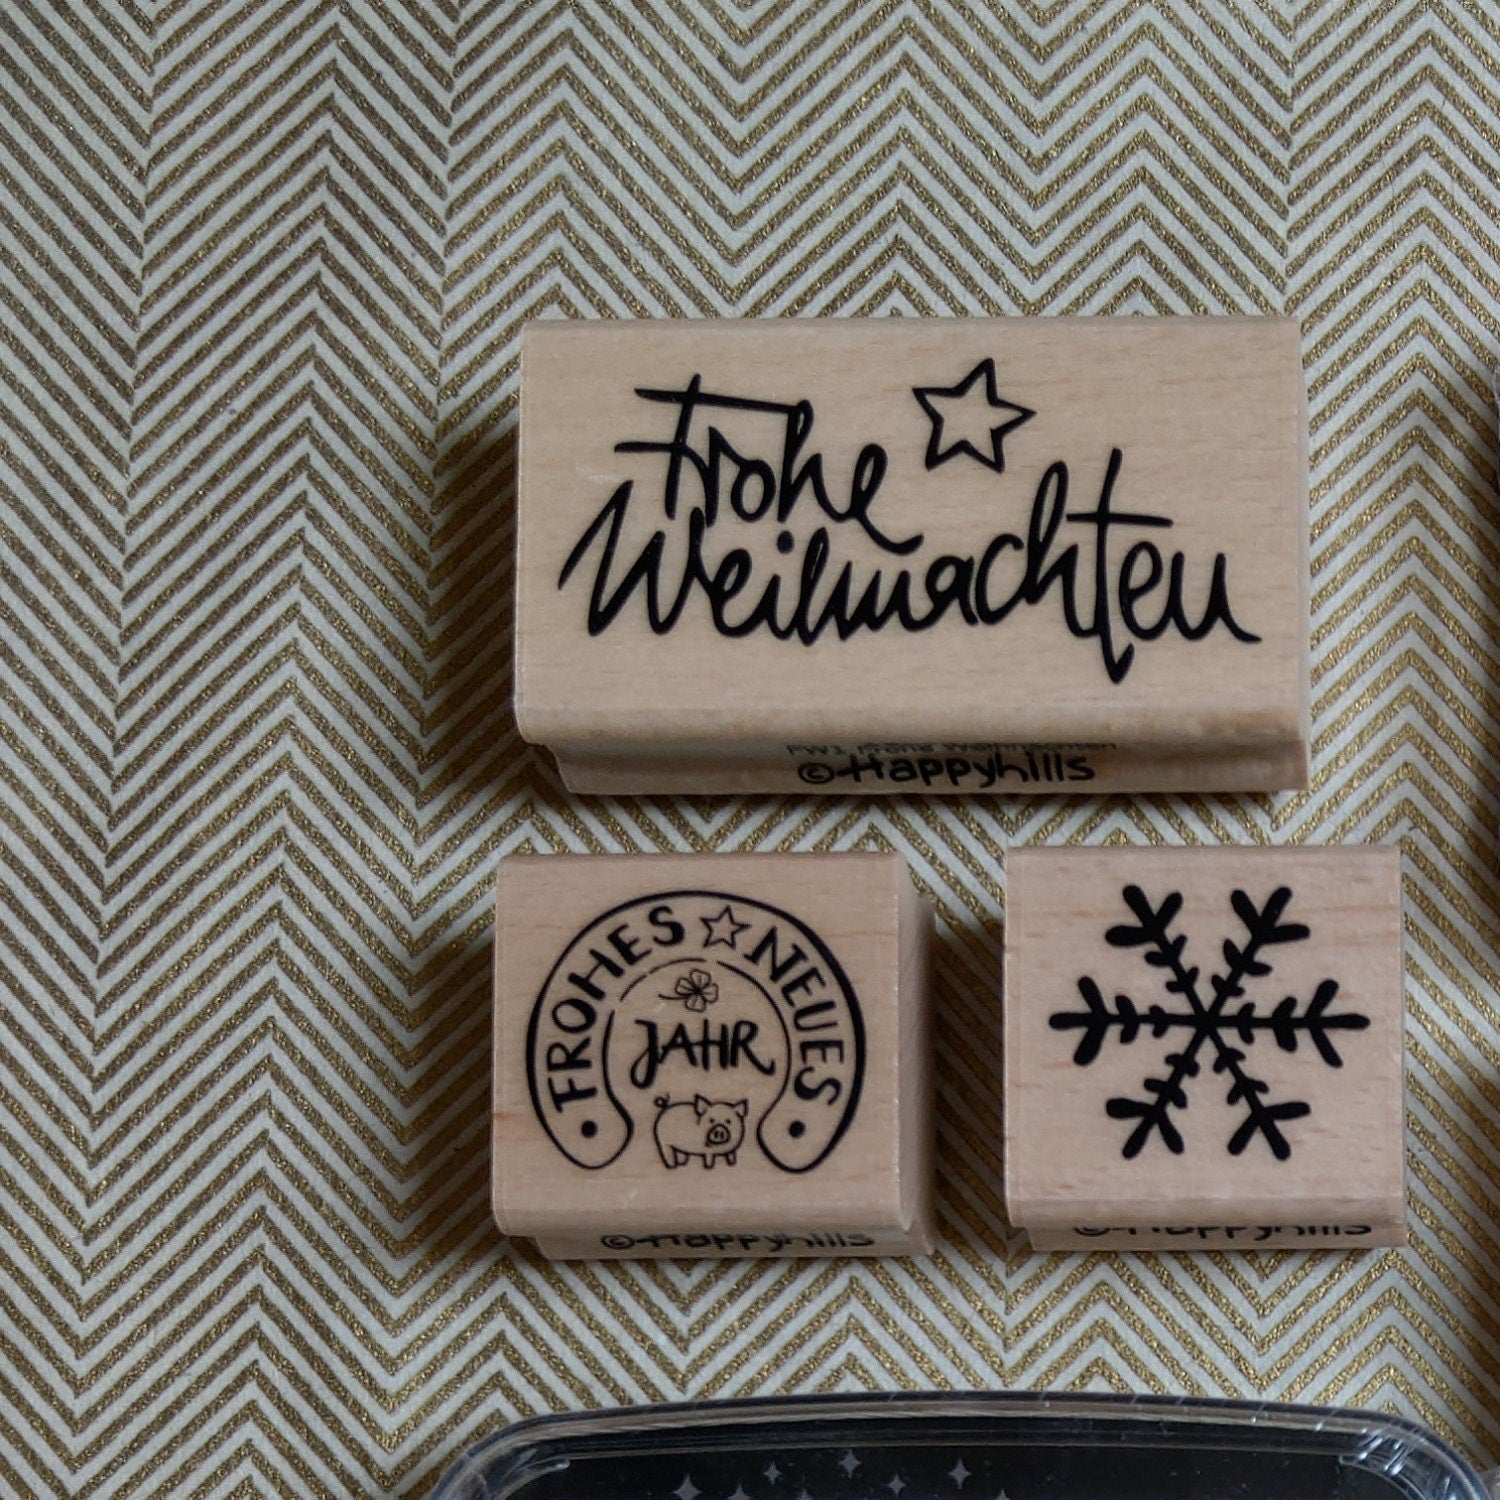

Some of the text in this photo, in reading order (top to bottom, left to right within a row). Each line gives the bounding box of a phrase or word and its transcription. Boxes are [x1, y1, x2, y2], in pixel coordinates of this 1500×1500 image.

[614, 373, 924, 552] Frohe
[558, 448, 1262, 685] Weihnachten
[546, 905, 846, 1113] FROHES NEUES
[630, 1018, 776, 1090] JAHR
